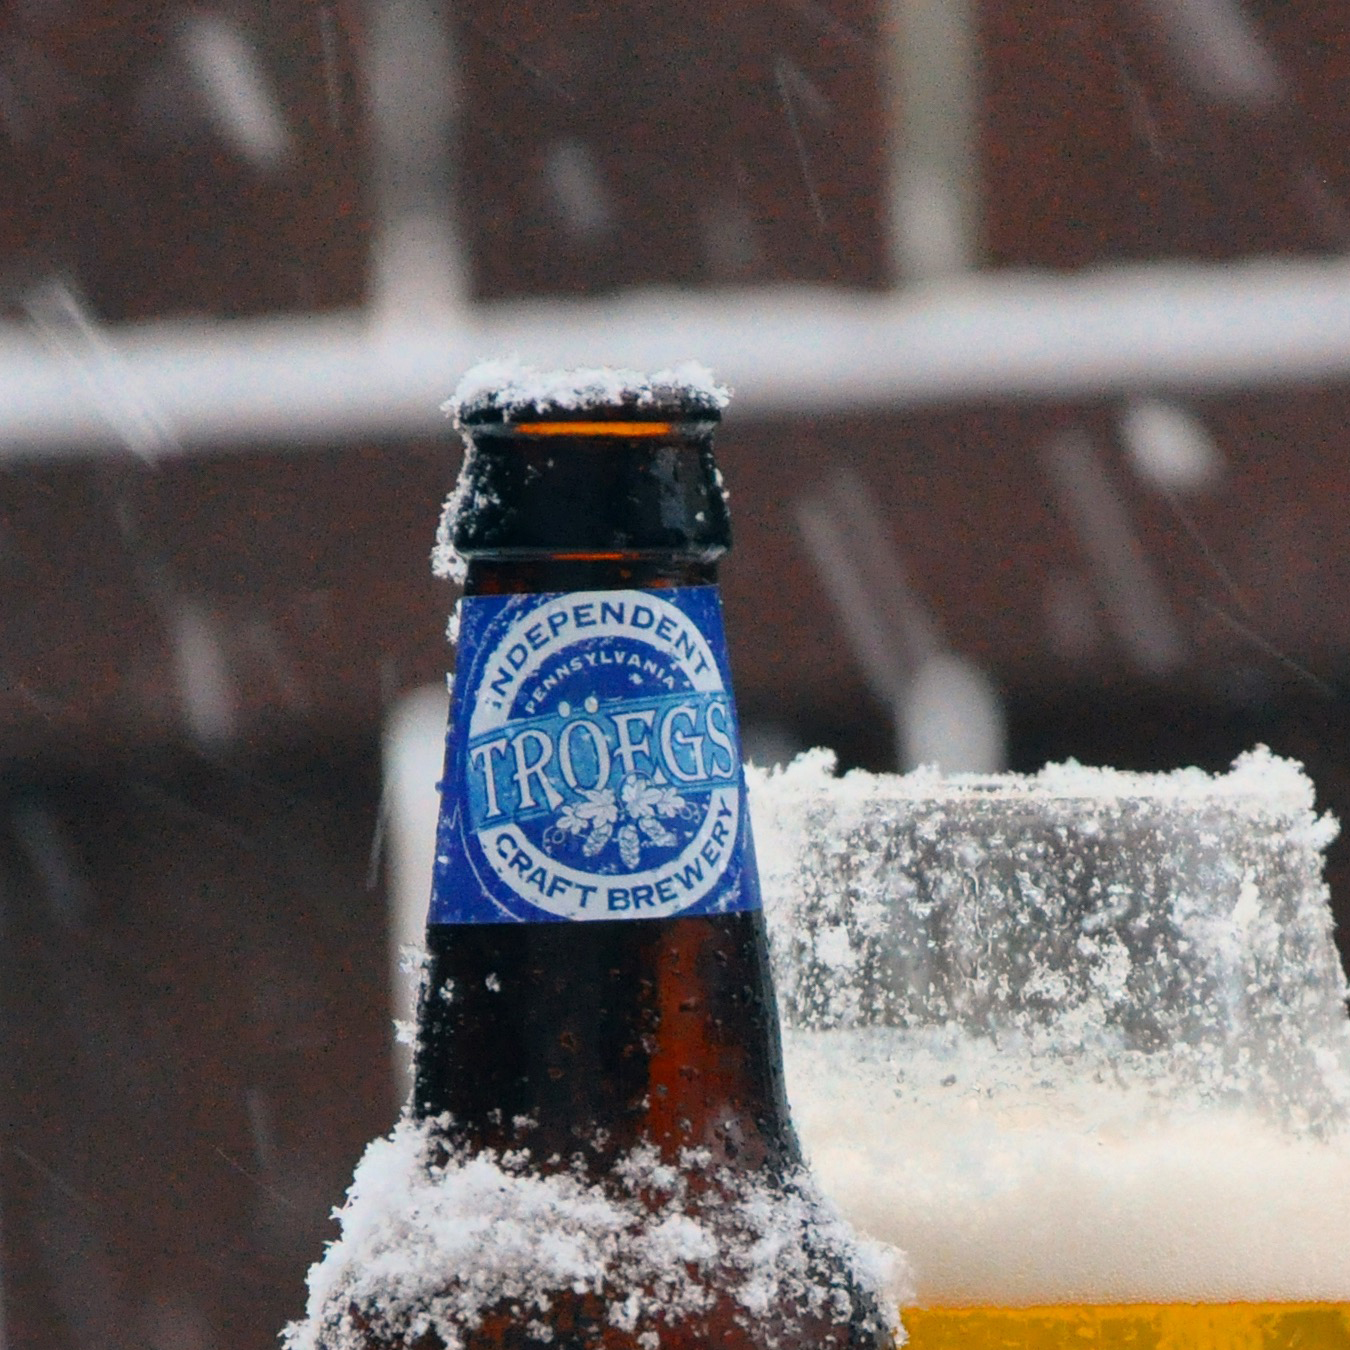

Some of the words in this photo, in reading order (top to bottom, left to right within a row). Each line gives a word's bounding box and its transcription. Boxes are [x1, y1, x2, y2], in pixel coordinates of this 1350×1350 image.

[491, 601, 711, 710] INDEPENDENT
[525, 650, 676, 714] PENNSYLVANIA
[495, 832, 598, 908] CRAFT
[607, 796, 734, 911] BREWERY
